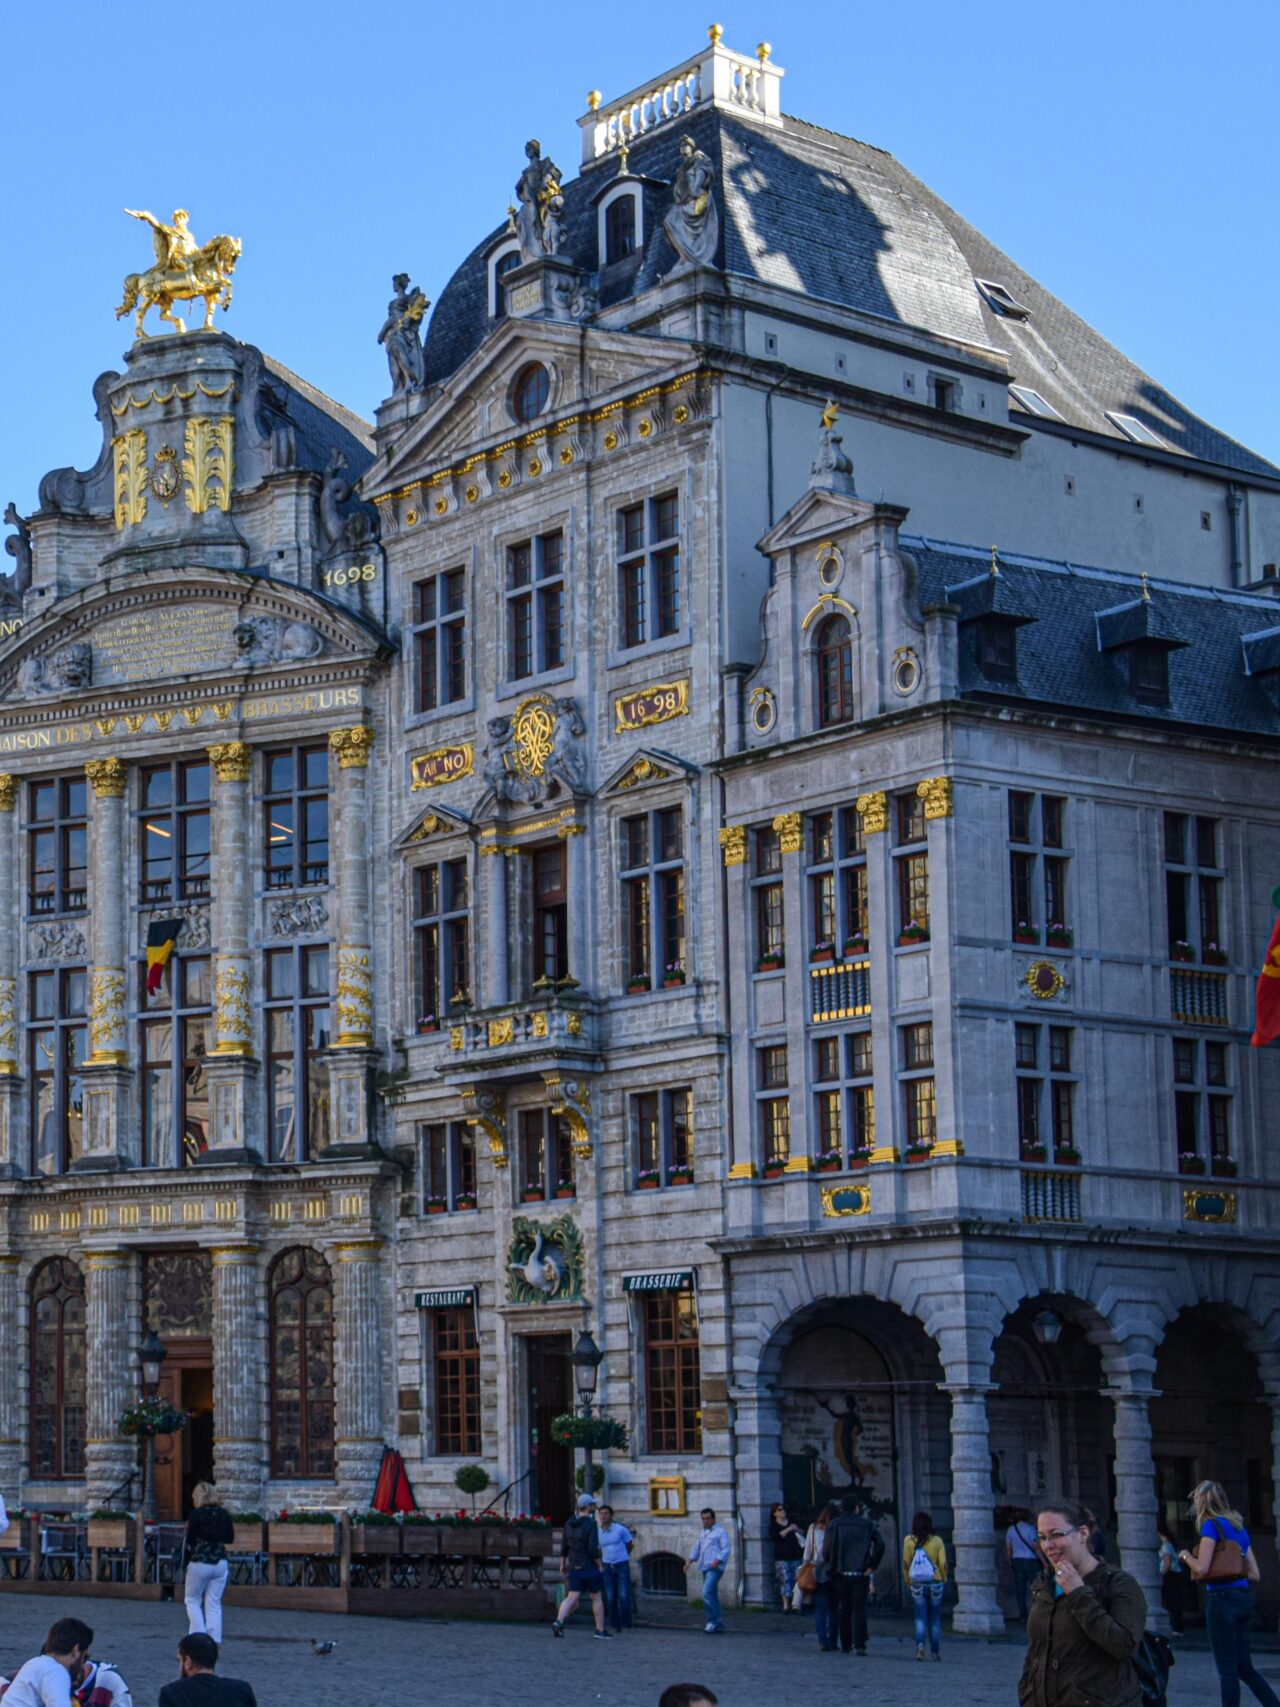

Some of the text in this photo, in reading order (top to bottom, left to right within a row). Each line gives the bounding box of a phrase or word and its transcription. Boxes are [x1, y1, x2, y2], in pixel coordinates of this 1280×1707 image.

[323, 564, 376, 586] 1698
[243, 688, 360, 720] BRASSEURS
[56, 724, 93, 745] DES
[629, 1274, 681, 1289] BRASSERIE
[420, 1291, 465, 1306] RESTAURANT
